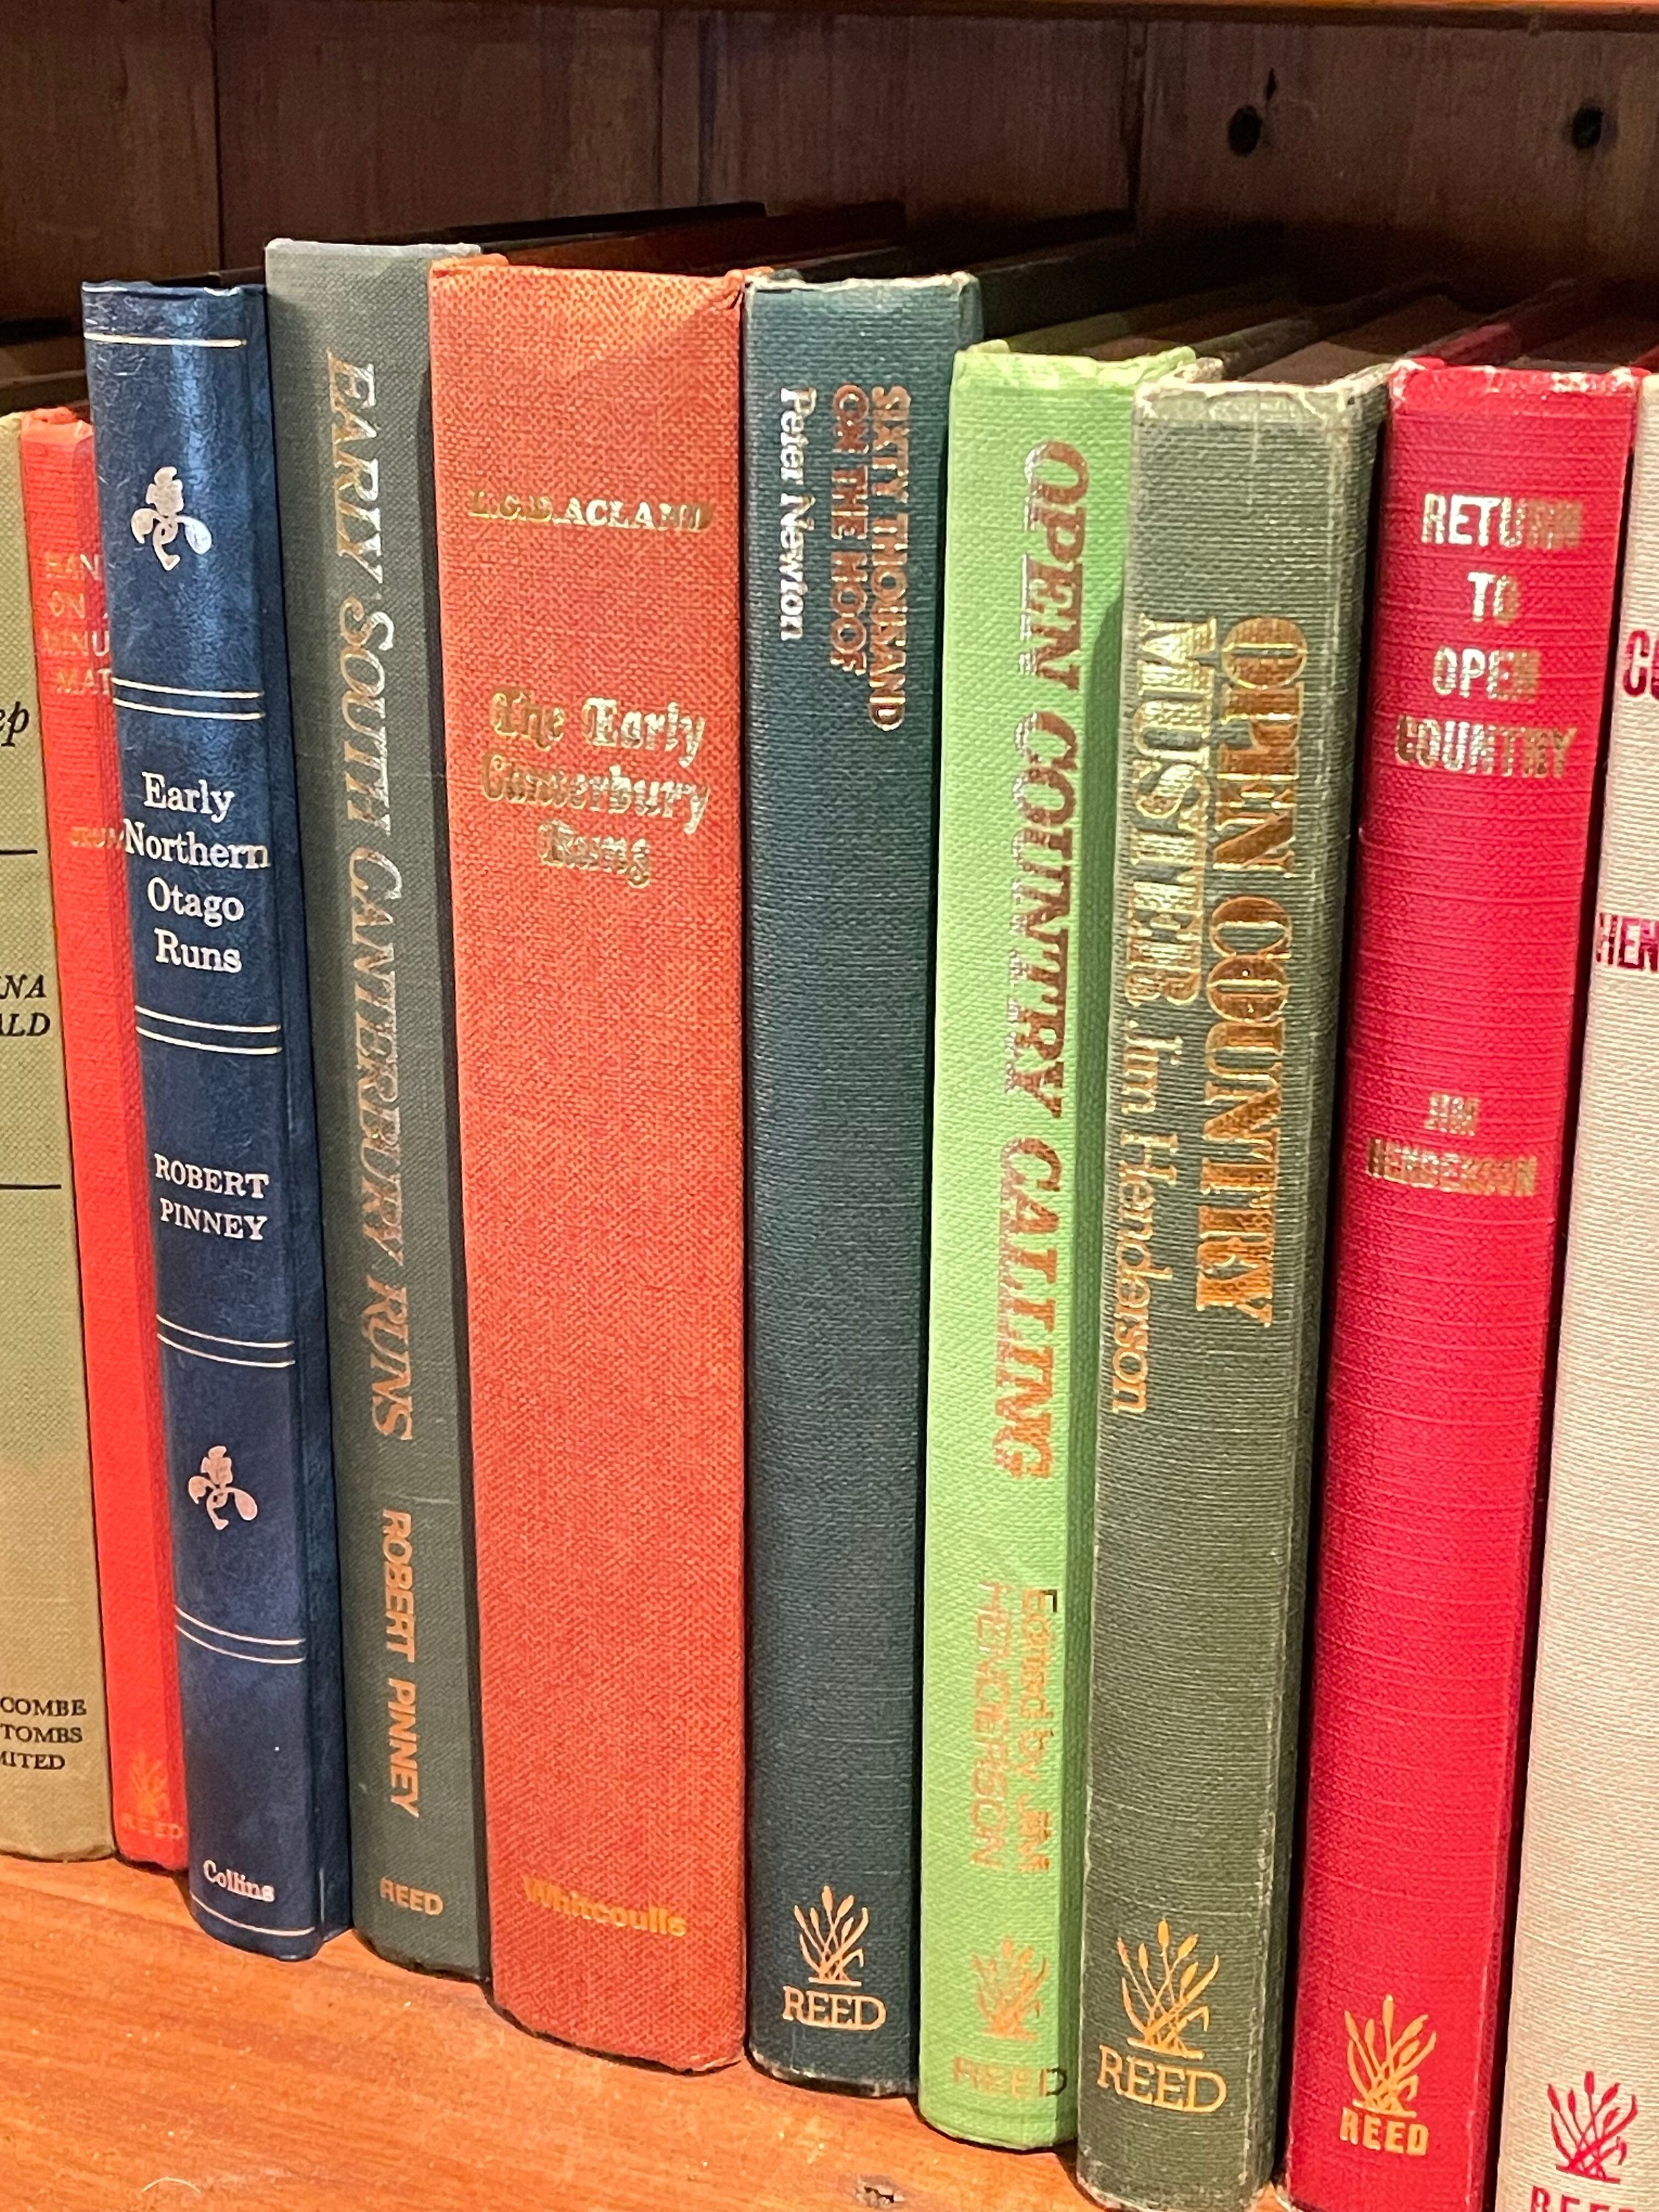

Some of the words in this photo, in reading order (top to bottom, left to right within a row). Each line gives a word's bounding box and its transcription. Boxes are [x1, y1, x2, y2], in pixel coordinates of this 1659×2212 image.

[780, 387, 817, 485] Peter
[832, 384, 869, 454] ON
[871, 385, 911, 503] SIXTY
[328, 350, 383, 583] EARLY
[831, 466, 868, 540] THE
[780, 493, 816, 640] Newton
[1019, 441, 1088, 691] OPEN
[1467, 571, 1518, 624] TO
[830, 551, 867, 676] HOOF
[869, 513, 908, 731] THOUSAND
[340, 597, 394, 836] SOUTH
[581, 697, 705, 767] Early
[1213, 617, 1307, 879] OPEN
[1395, 715, 1577, 778] COUNTRY
[141, 771, 235, 823] Early
[1125, 613, 1217, 1006] MUSTER
[123, 818, 271, 869] Northern
[147, 877, 244, 928] Otago
[1005, 711, 1078, 1118] COUNTRY
[155, 928, 242, 974] Runs
[350, 848, 403, 1266] CANTERBURY
[1197, 896, 1291, 1327] COUNTRY
[155, 1153, 269, 1199] ROBERT
[160, 1198, 267, 1240] PINNEY
[993, 1136, 1061, 1479] CALLING
[1112, 1130, 1179, 1415] Henderson
[363, 1275, 413, 1440] RUNS
[382, 1509, 415, 1662] ROBERT
[0, 1696, 87, 1716] COMBE
[0, 1724, 83, 1743] TOMBS
[388, 1678, 419, 1818] PINNEY
[1013, 1730, 1054, 1781] by
[203, 1860, 275, 1902] Collins
[380, 1876, 444, 1915] REED
[783, 1986, 887, 2030] REED
[953, 2056, 1066, 2097] REED
[1097, 2045, 1228, 2113] REED
[1340, 2107, 1429, 2156] REED
